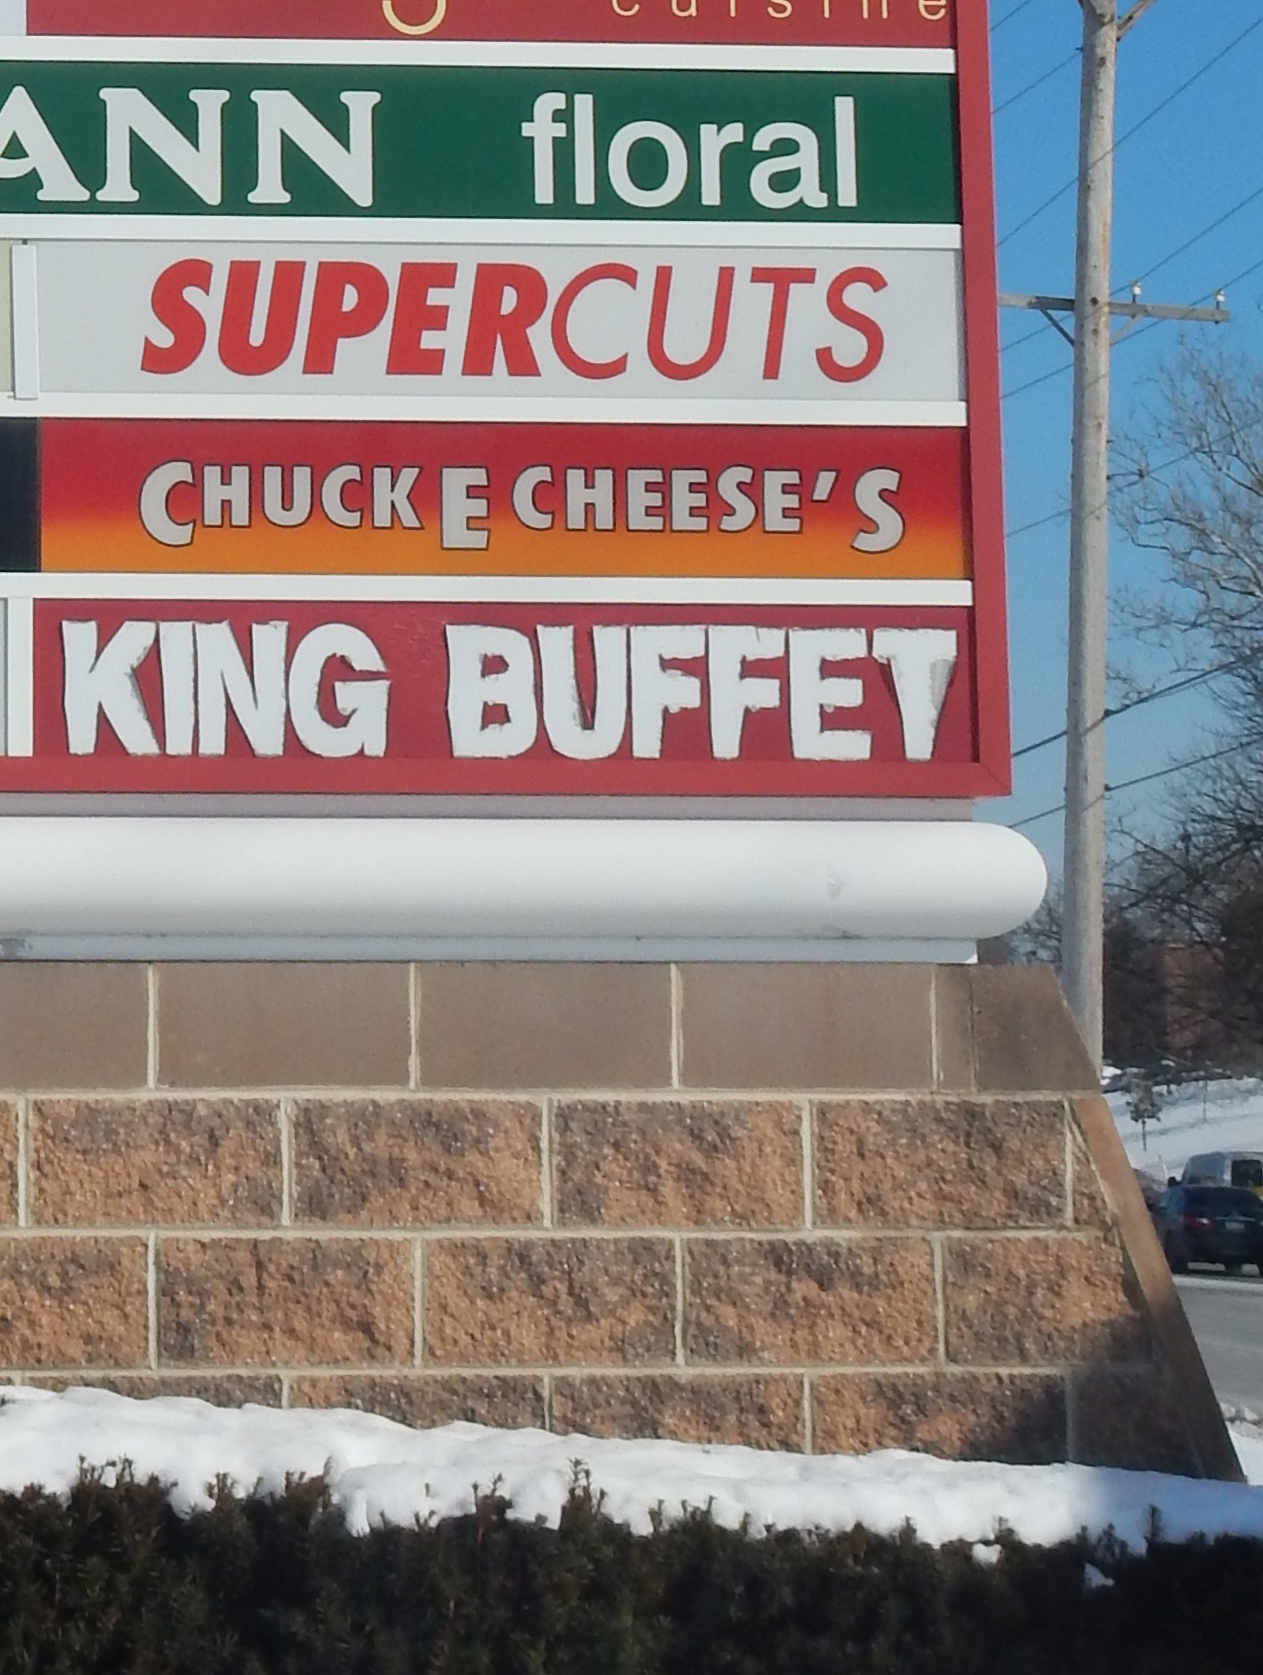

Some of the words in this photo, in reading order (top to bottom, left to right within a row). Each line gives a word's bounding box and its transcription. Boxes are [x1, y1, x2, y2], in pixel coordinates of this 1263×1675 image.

[521, 91, 858, 210] floral
[139, 257, 890, 385] SUPERCUTS
[138, 459, 425, 548] CHUCK
[439, 465, 490, 551] E
[510, 464, 905, 553] CHEESE'S
[59, 619, 394, 760] KING
[444, 622, 959, 763] BUFFET
